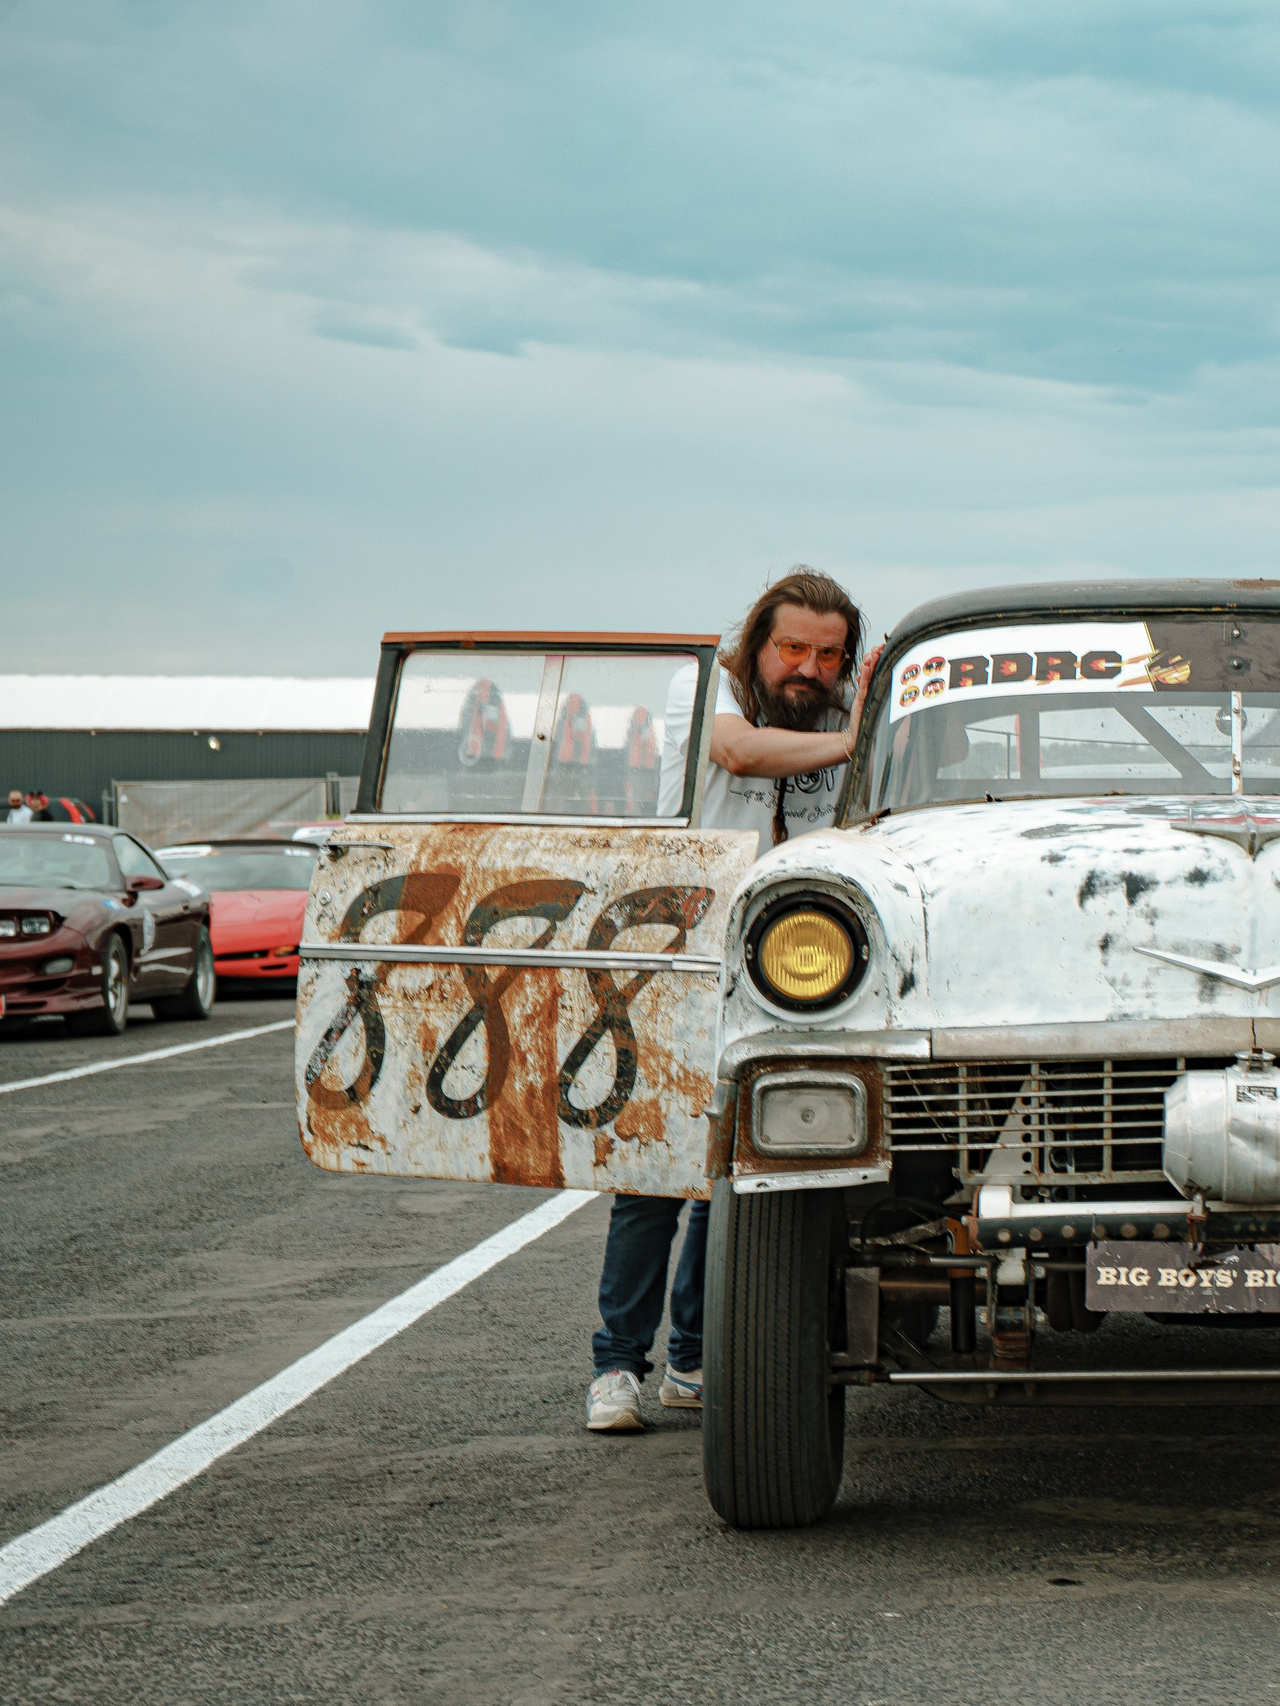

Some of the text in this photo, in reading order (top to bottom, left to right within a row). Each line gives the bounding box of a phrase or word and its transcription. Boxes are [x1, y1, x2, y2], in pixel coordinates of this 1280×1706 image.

[948, 650, 1123, 690] RDRC
[1096, 1266, 1151, 1287] BIG
[1157, 1267, 1238, 1288] BOYS'
